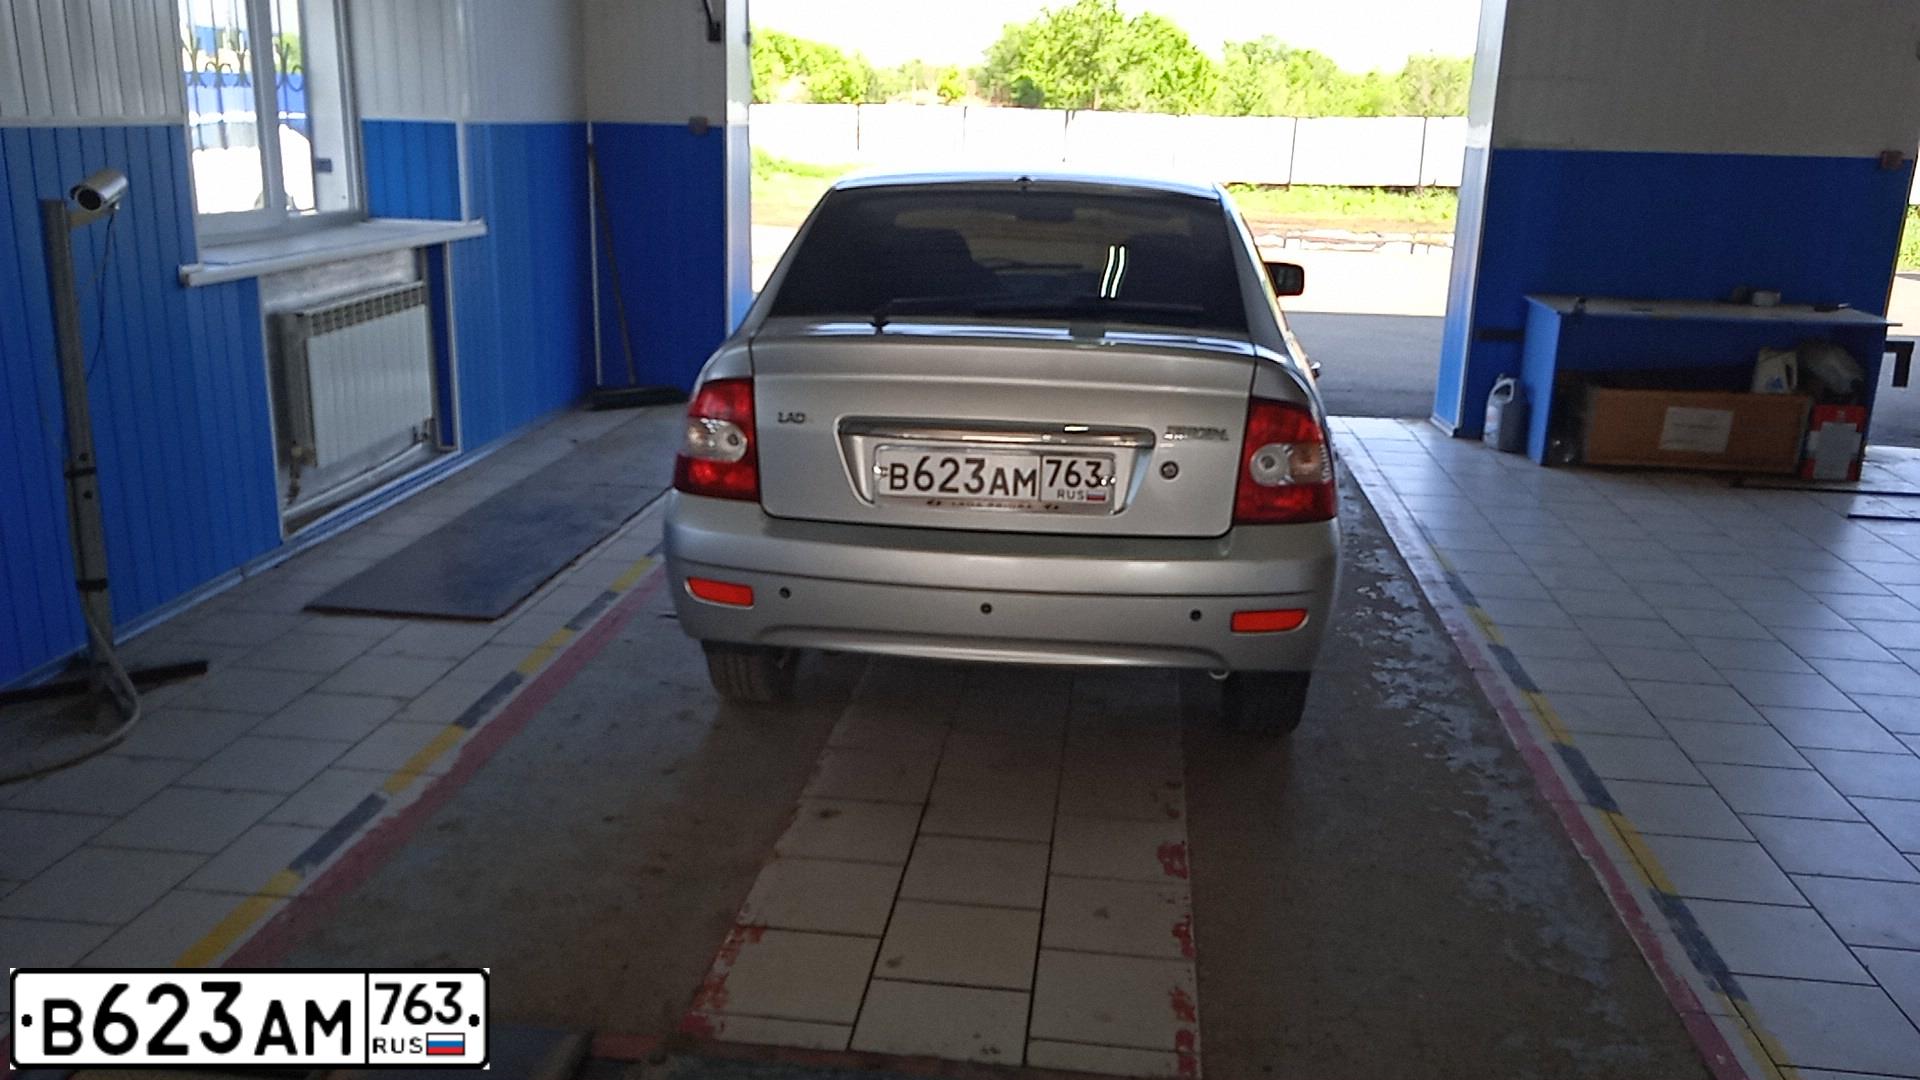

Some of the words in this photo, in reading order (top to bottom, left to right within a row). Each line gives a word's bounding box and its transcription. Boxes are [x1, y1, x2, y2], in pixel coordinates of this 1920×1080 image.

[777, 411, 813, 424] LAD
[889, 456, 1037, 497] B623AM
[1045, 459, 1102, 488] 763
[1056, 489, 1085, 500] RUS
